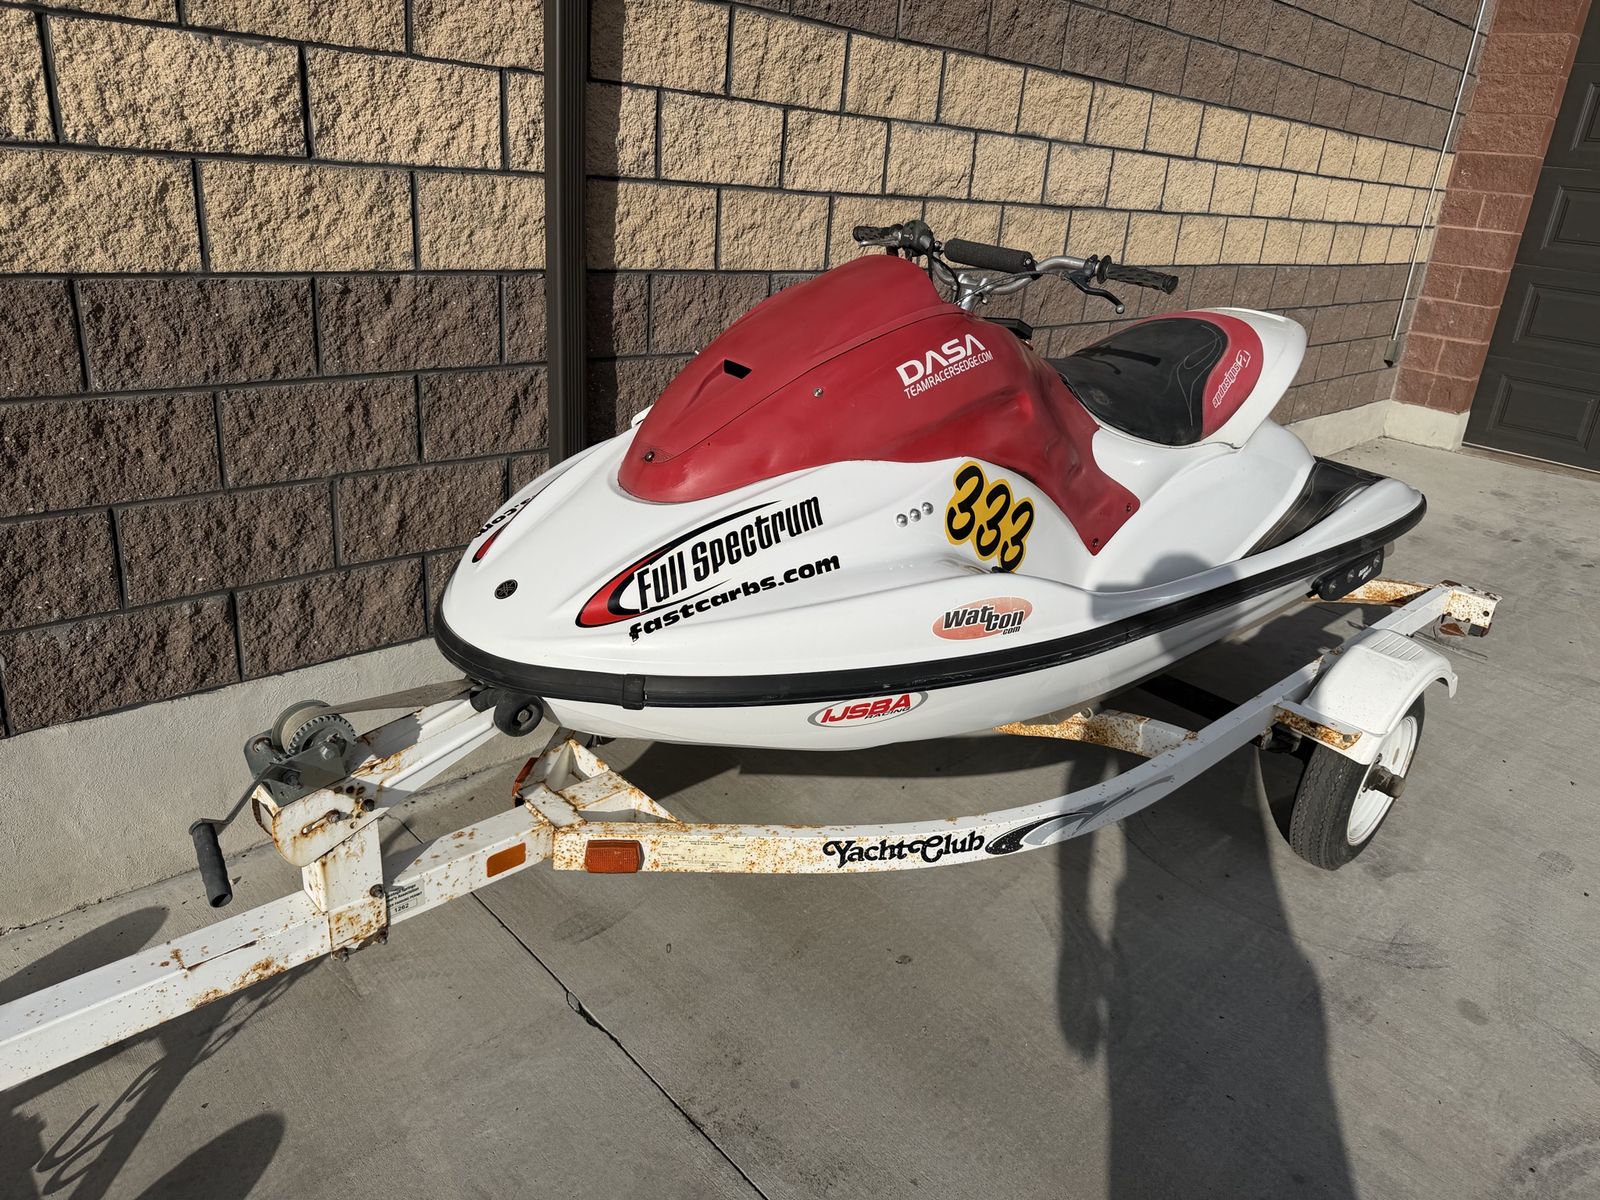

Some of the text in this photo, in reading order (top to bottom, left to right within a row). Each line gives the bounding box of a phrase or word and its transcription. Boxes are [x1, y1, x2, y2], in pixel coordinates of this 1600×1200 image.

[896, 333, 985, 386] DASA
[904, 350, 994, 399] TEAMRACERSEDGE.COM
[946, 465, 1035, 573] 333
[636, 496, 824, 612] Full Spectrum
[629, 554, 841, 642] fastcarbs.com
[820, 694, 911, 723] IJSBA
[864, 706, 911, 719] RACING
[822, 831, 985, 868] Yacht Club
